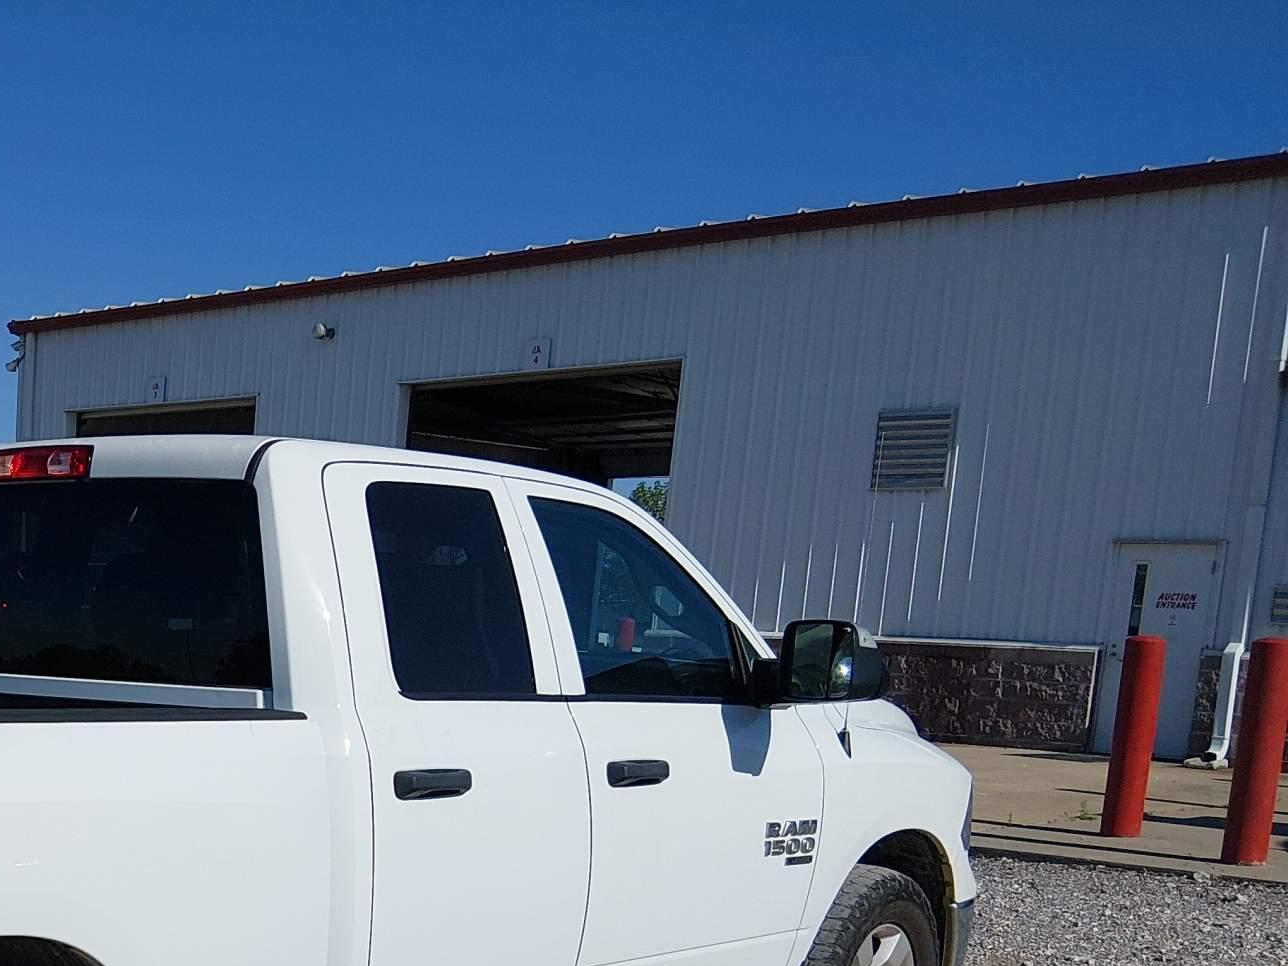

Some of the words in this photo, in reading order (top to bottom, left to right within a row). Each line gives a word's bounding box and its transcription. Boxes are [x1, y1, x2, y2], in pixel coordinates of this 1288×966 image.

[1158, 592, 1197, 601] AUCTION
[1155, 601, 1197, 610] ENTRANCE
[765, 819, 818, 838] RAM
[763, 837, 816, 857] 1500
